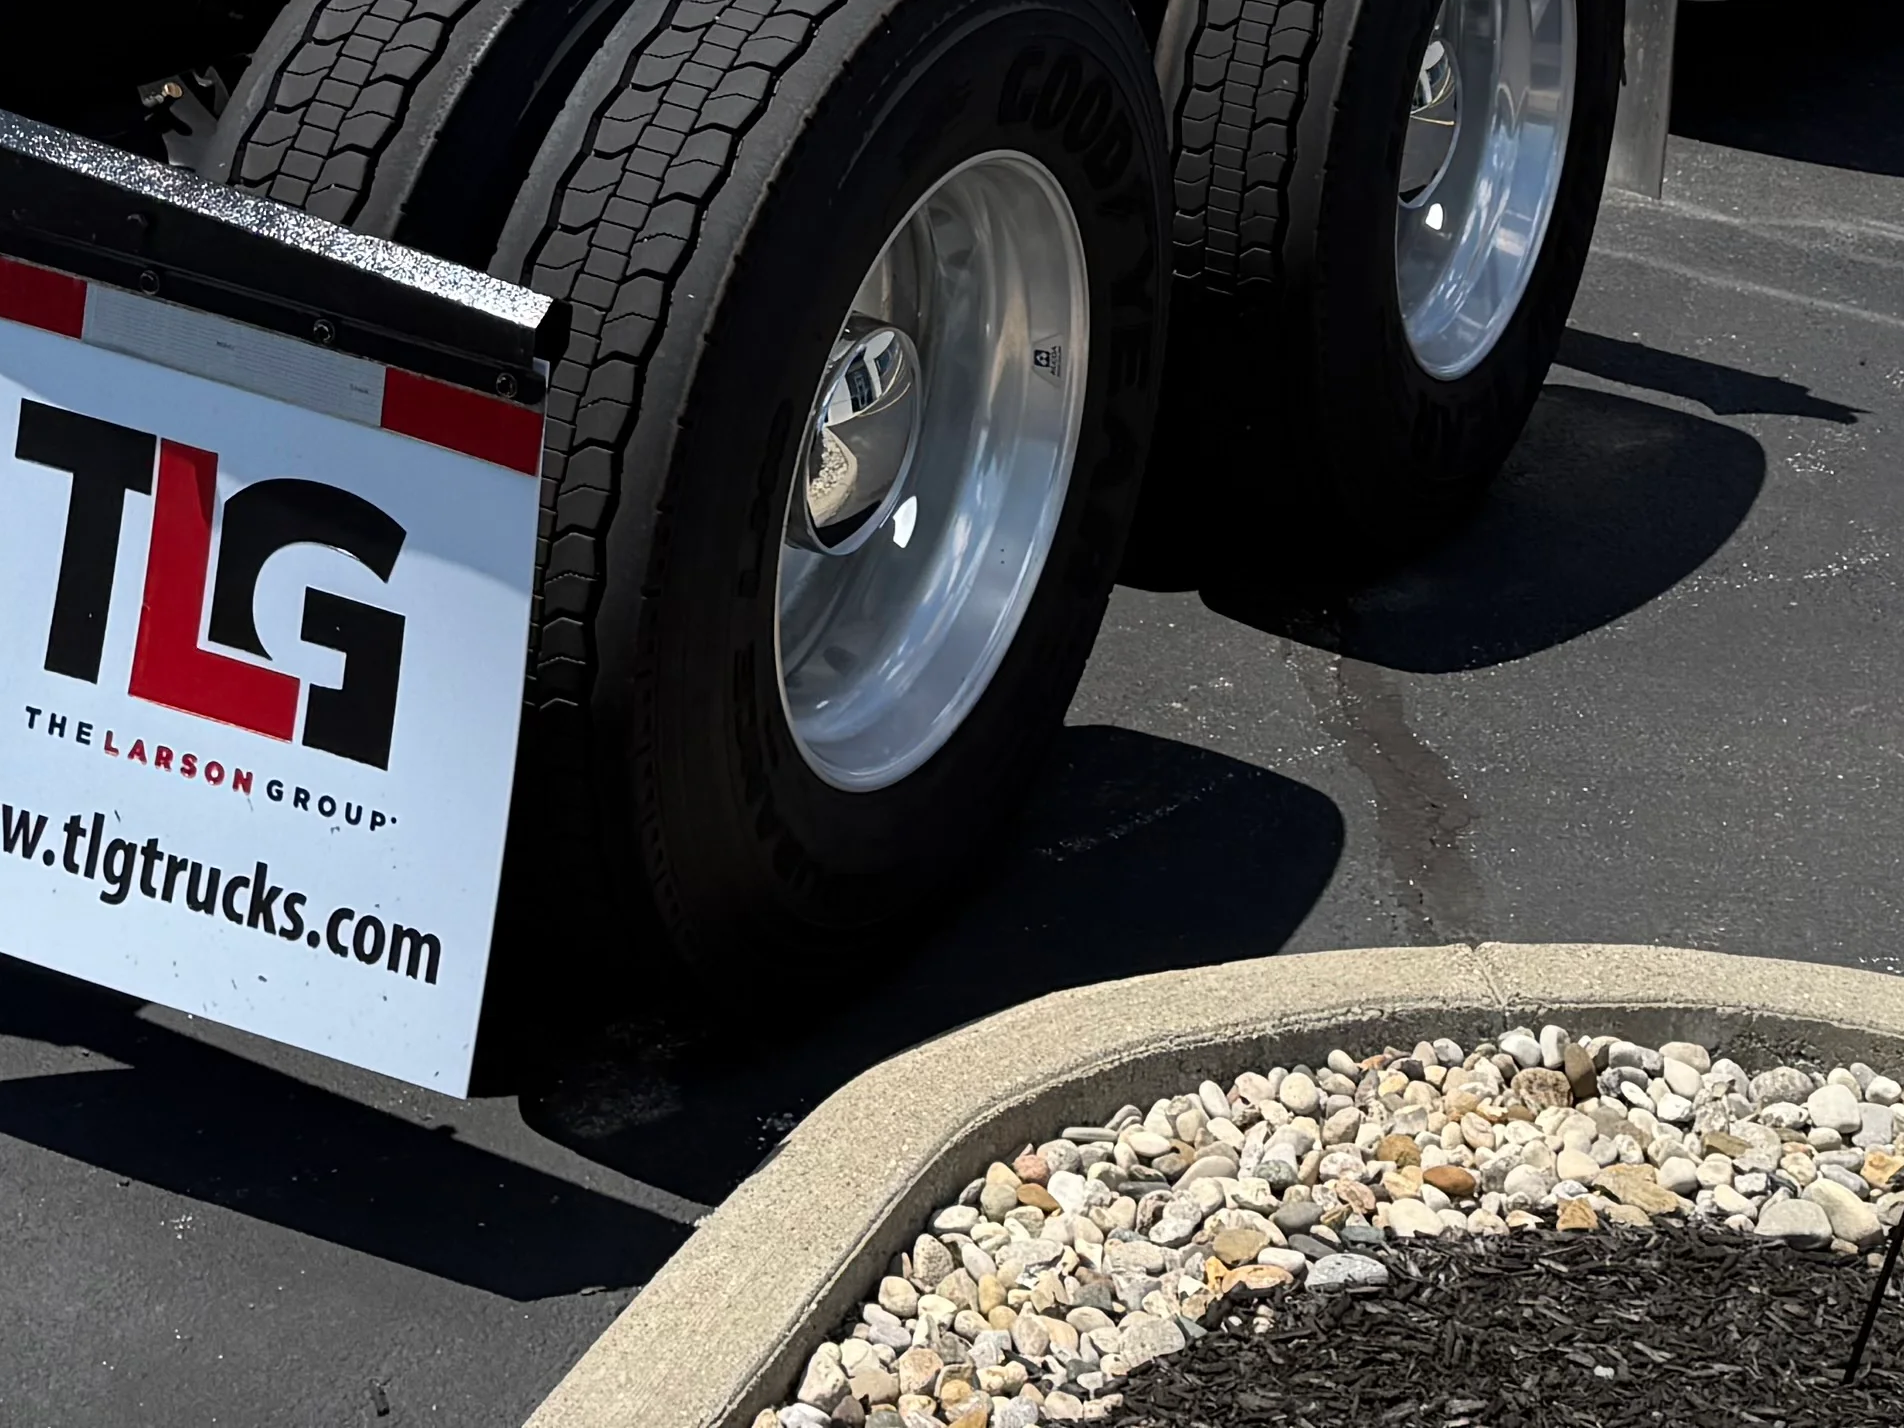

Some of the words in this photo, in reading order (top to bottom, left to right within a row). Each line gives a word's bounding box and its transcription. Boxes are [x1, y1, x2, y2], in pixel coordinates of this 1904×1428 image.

[14, 397, 407, 772] TLG
[24, 705, 94, 745] THE
[103, 729, 254, 797] LARSON
[265, 778, 388, 833] GROUP
